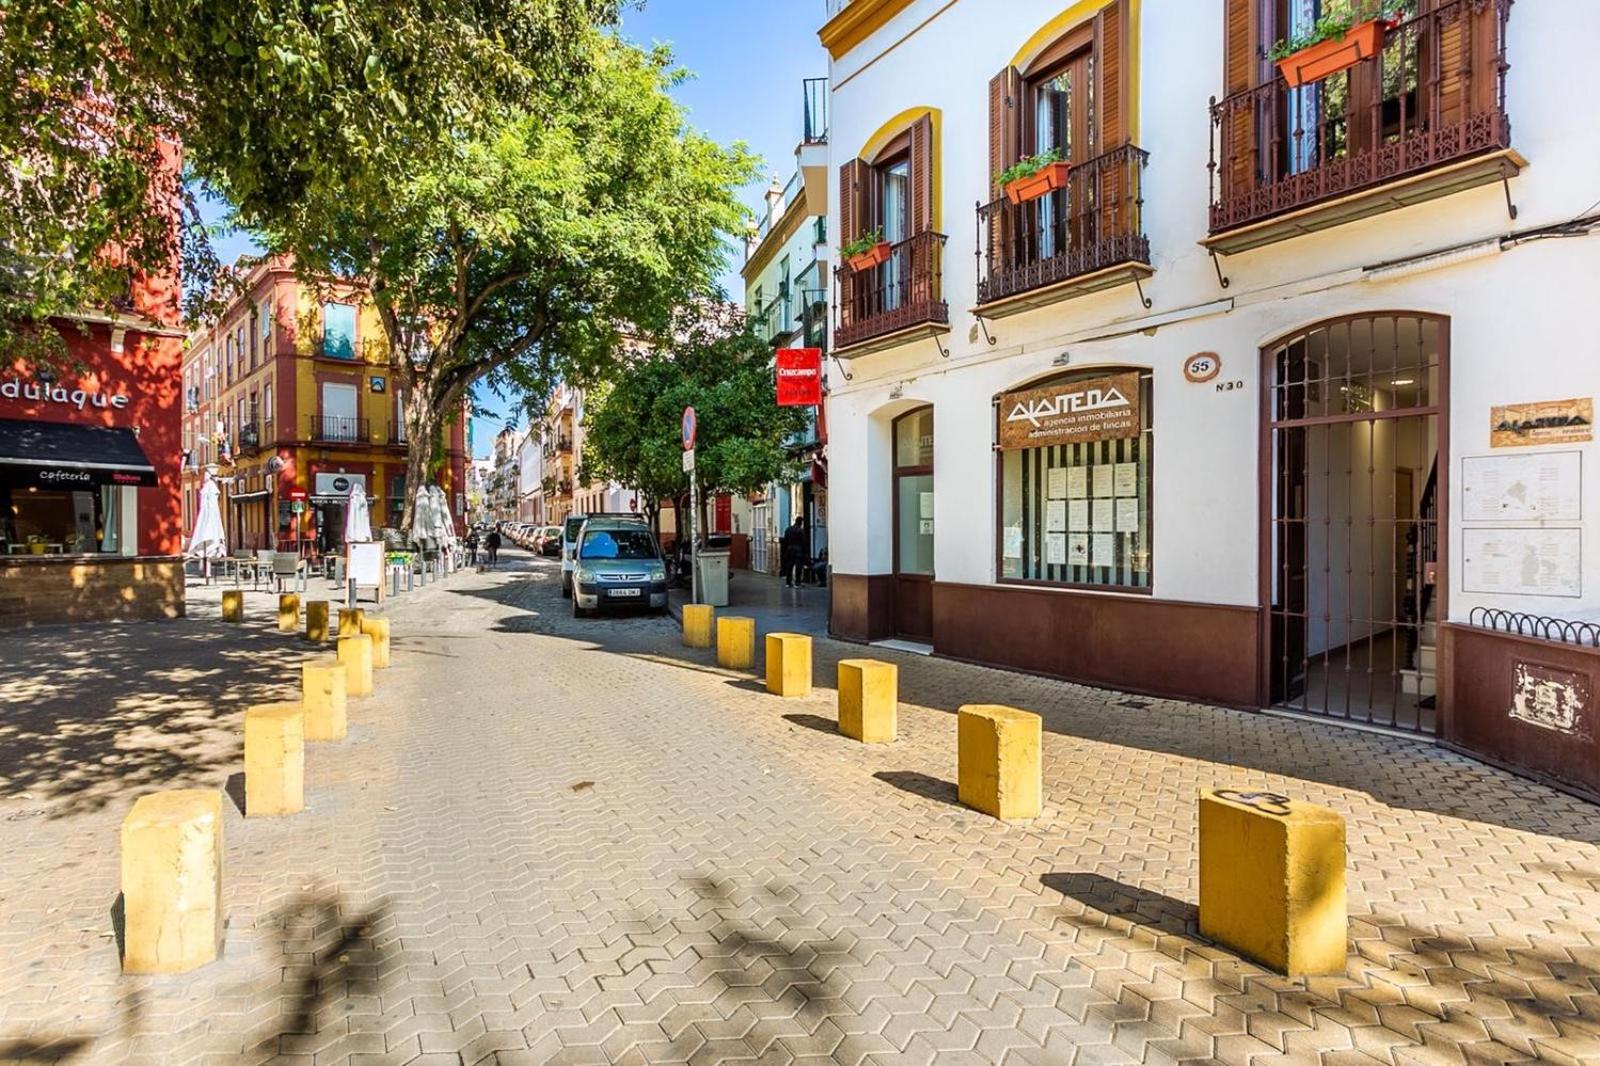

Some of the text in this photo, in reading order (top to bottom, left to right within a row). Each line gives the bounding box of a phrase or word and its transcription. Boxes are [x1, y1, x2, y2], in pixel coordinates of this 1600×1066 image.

[1191, 361, 1209, 373] 55
[1, 378, 129, 409] dulaque
[1043, 409, 1131, 427] agencia inmobiliaria
[1089, 422, 1101, 431] de
[1103, 420, 1131, 430] fincas
